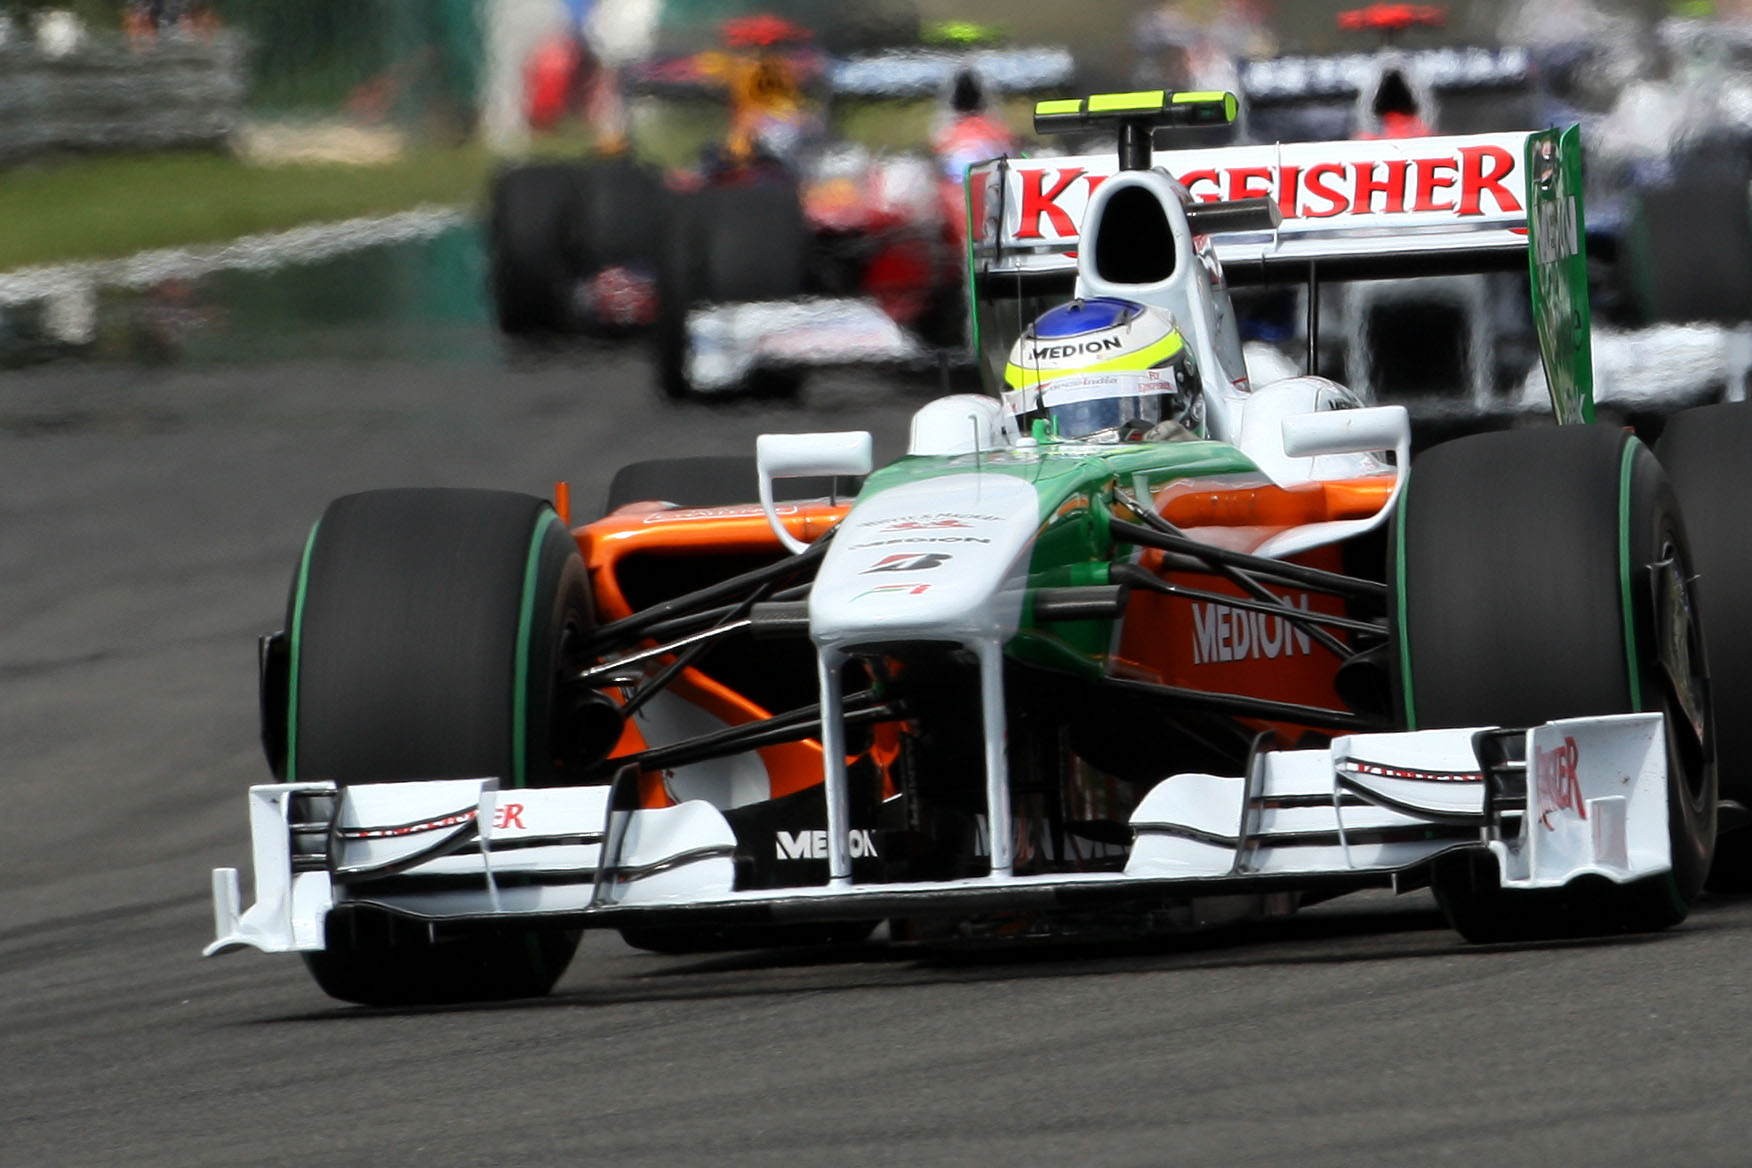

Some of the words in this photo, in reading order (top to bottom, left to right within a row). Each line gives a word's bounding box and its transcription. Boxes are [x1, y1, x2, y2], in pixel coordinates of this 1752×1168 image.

[1028, 335, 1123, 361] MEDION
[1191, 592, 1312, 665] MEDION
[775, 828, 879, 860] MEON
